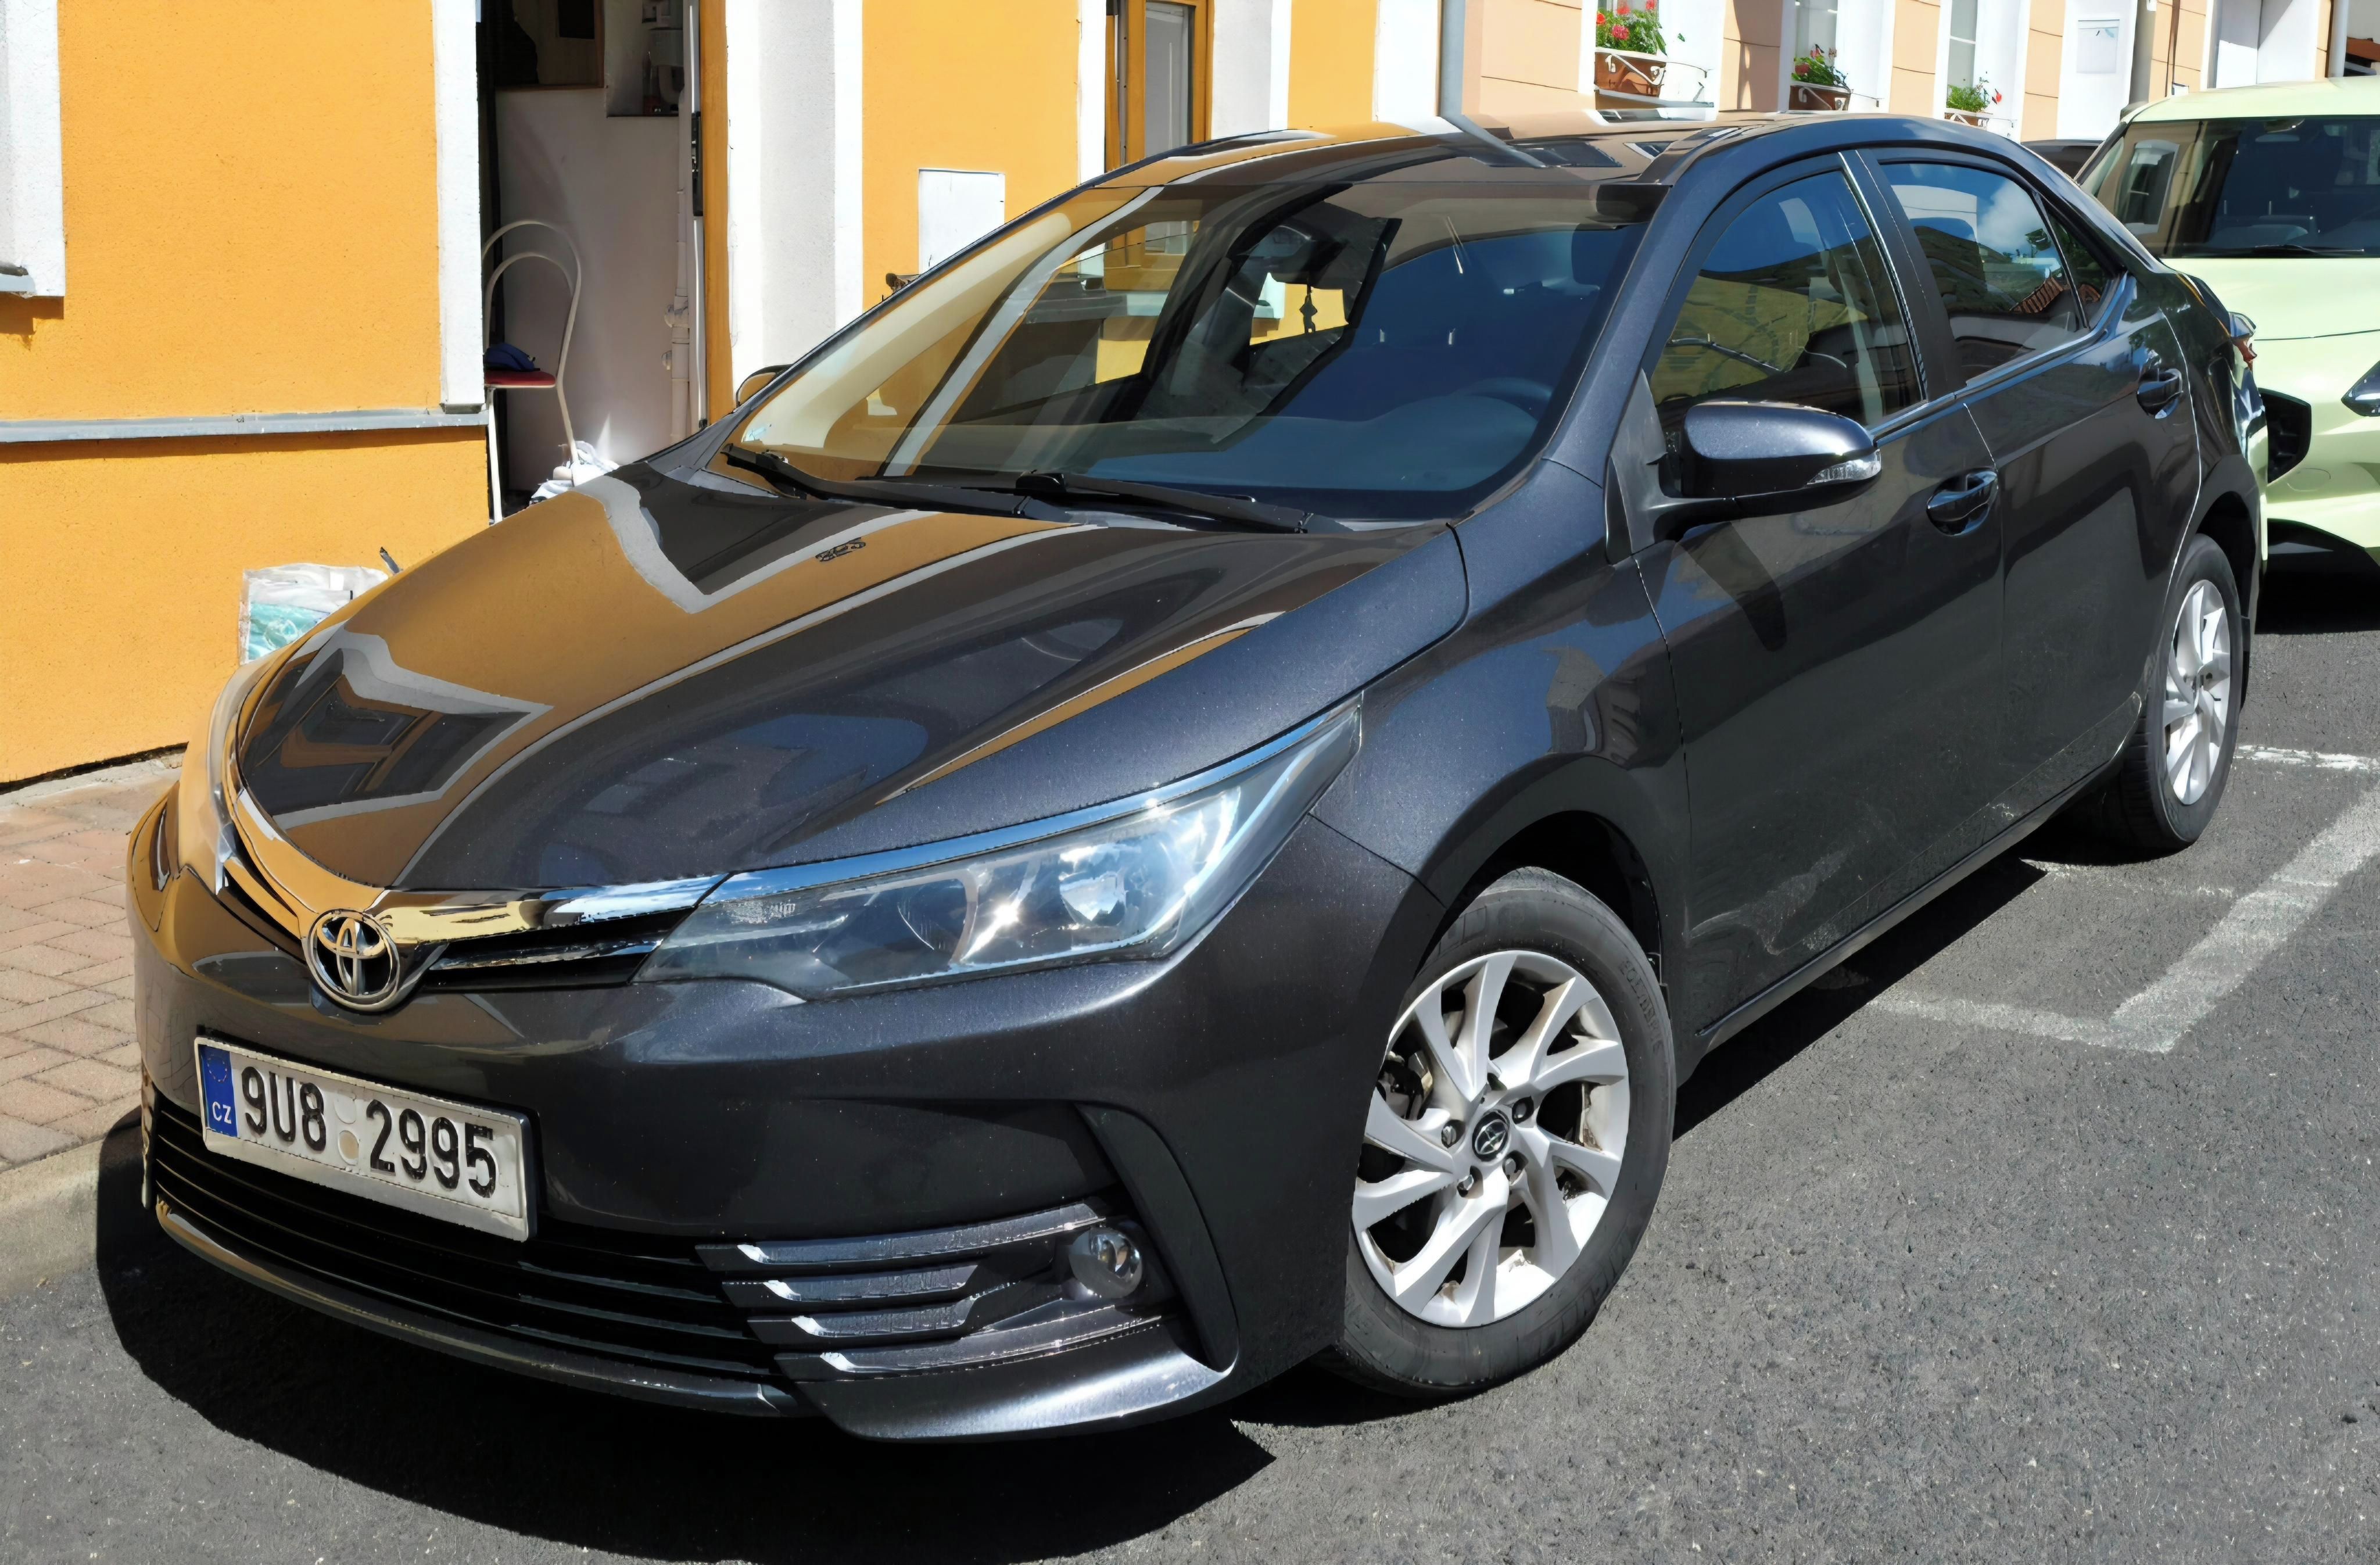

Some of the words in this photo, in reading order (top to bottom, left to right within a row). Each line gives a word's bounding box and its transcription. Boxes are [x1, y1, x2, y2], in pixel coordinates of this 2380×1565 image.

[212, 1101, 232, 1124] CZ
[242, 1066, 326, 1151] 9U8
[366, 1099, 496, 1198] 2995
